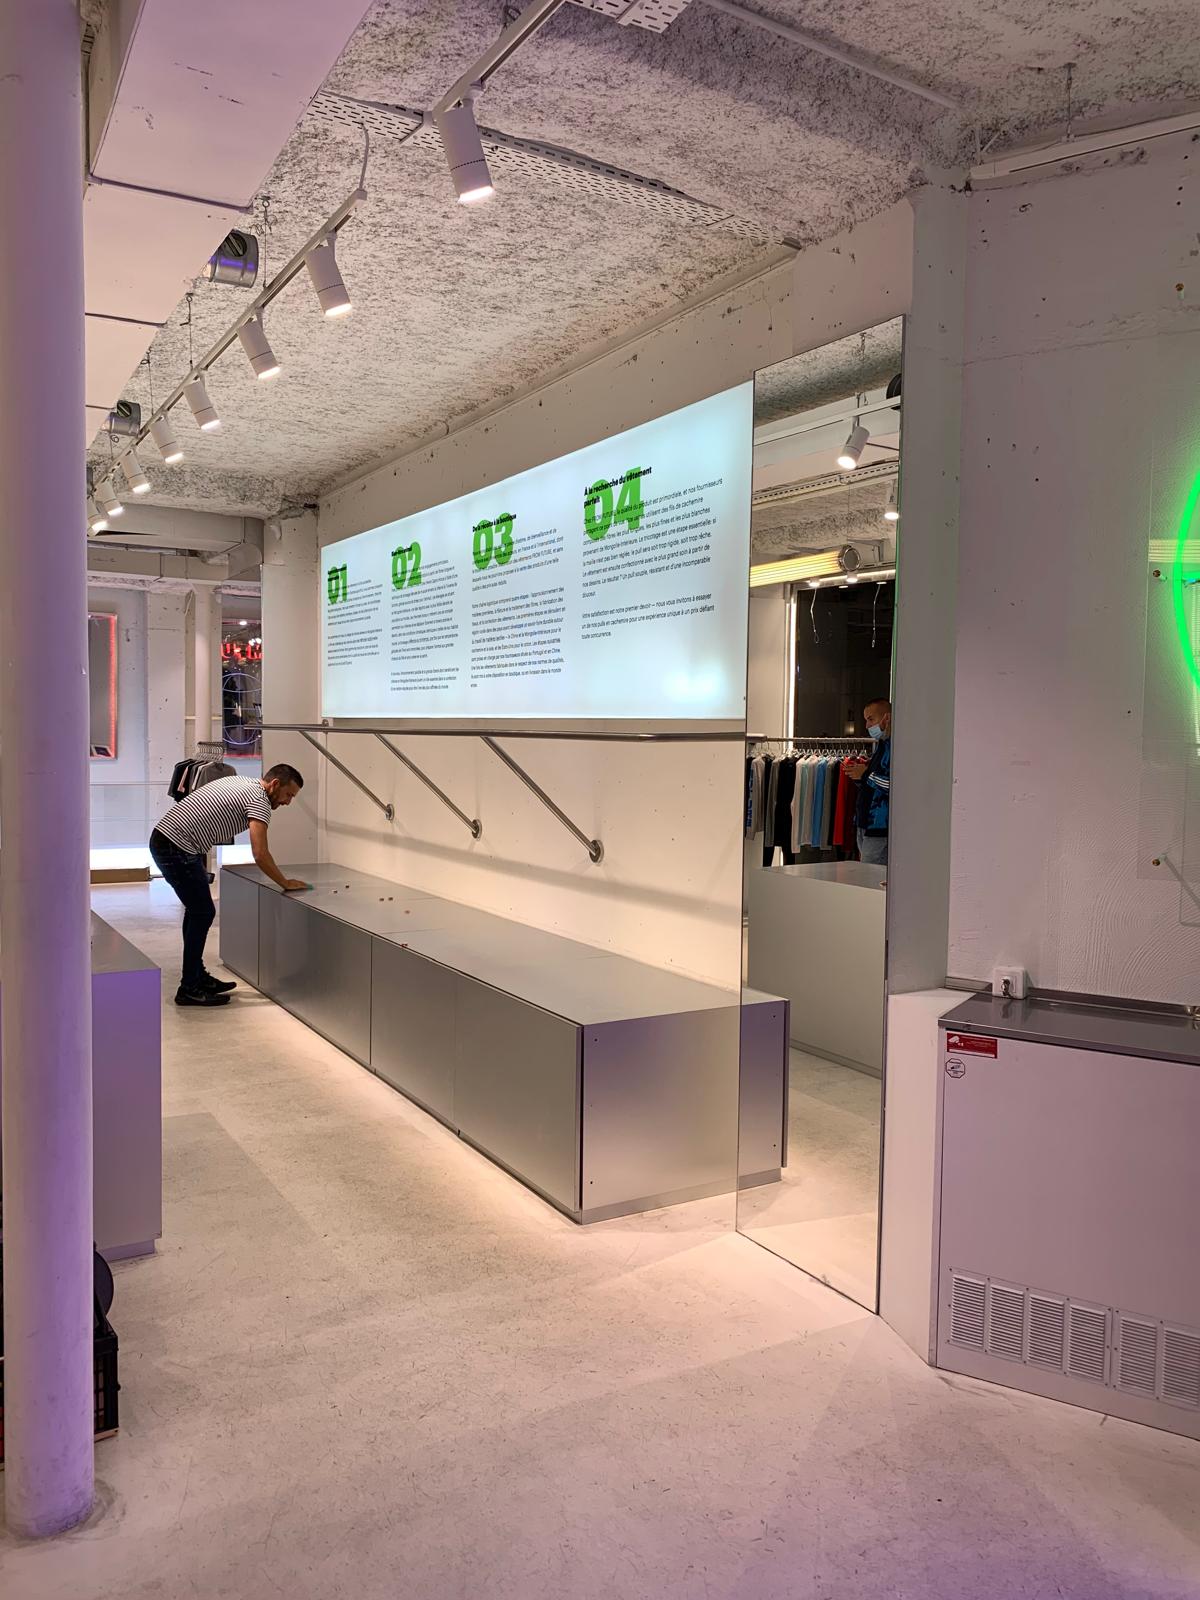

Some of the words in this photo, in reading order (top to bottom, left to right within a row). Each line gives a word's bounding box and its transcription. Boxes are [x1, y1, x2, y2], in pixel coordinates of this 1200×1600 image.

[594, 478, 618, 492] recherche
[627, 465, 651, 482] vêtement
[584, 496, 600, 508] parfait
[585, 466, 644, 541] 04
[473, 512, 514, 570] 03
[328, 564, 348, 605] 01
[392, 542, 422, 590] 02
